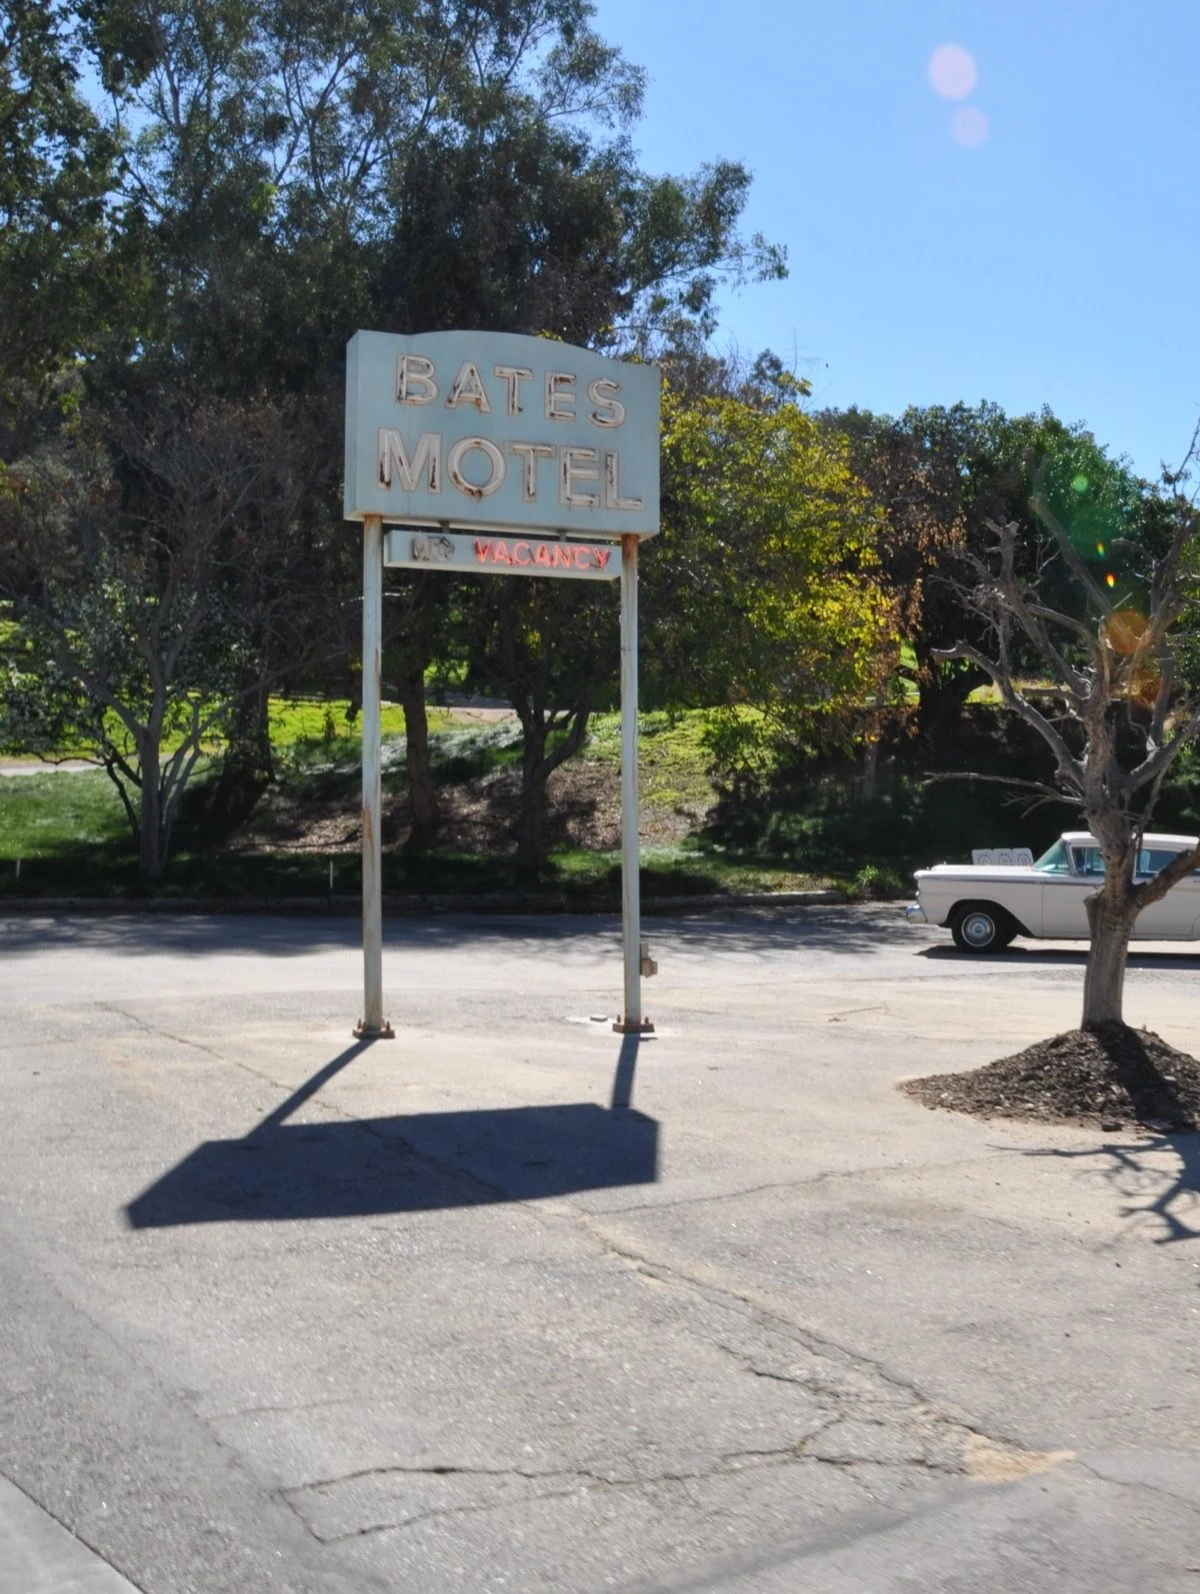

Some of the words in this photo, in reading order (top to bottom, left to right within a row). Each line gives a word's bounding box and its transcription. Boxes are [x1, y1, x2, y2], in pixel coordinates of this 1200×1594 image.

[396, 353, 626, 429] BATES
[377, 427, 645, 511] MOTEL
[475, 537, 611, 569] VACANCY
